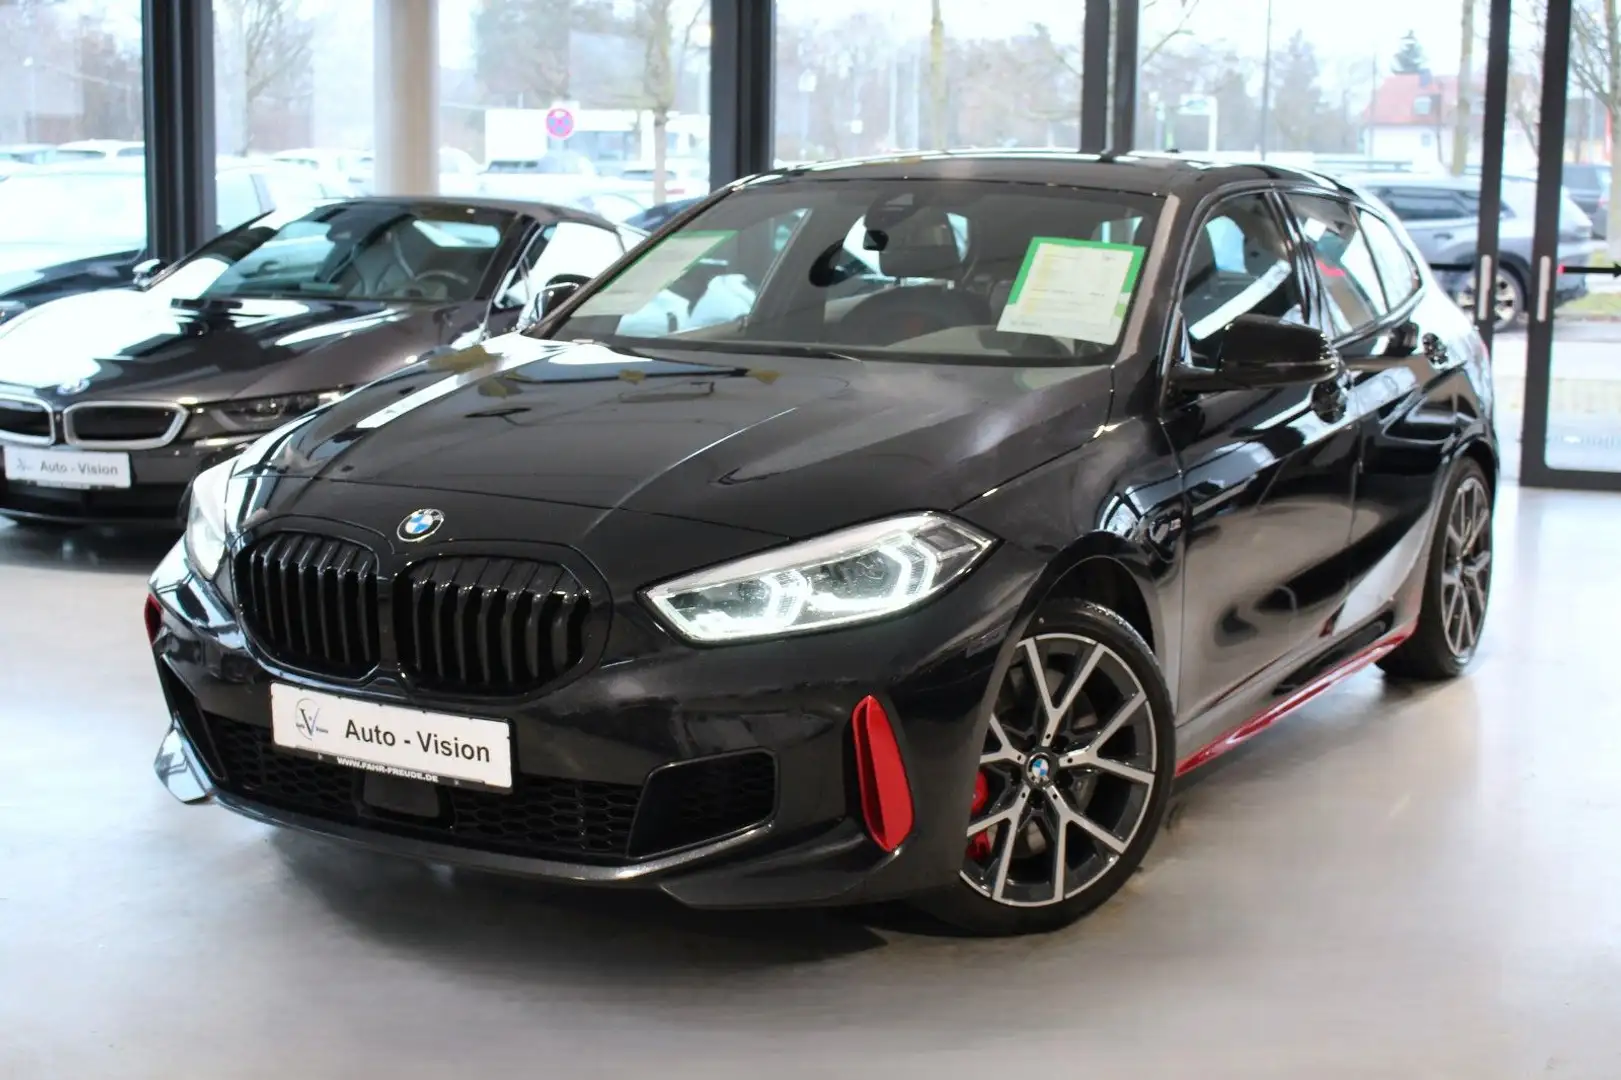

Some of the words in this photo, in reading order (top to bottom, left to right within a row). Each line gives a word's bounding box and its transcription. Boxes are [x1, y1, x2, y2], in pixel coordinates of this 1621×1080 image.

[40, 461, 68, 473] Auto
[78, 463, 118, 475] Vision
[345, 719, 396, 747] Auto
[416, 730, 490, 763] Vision
